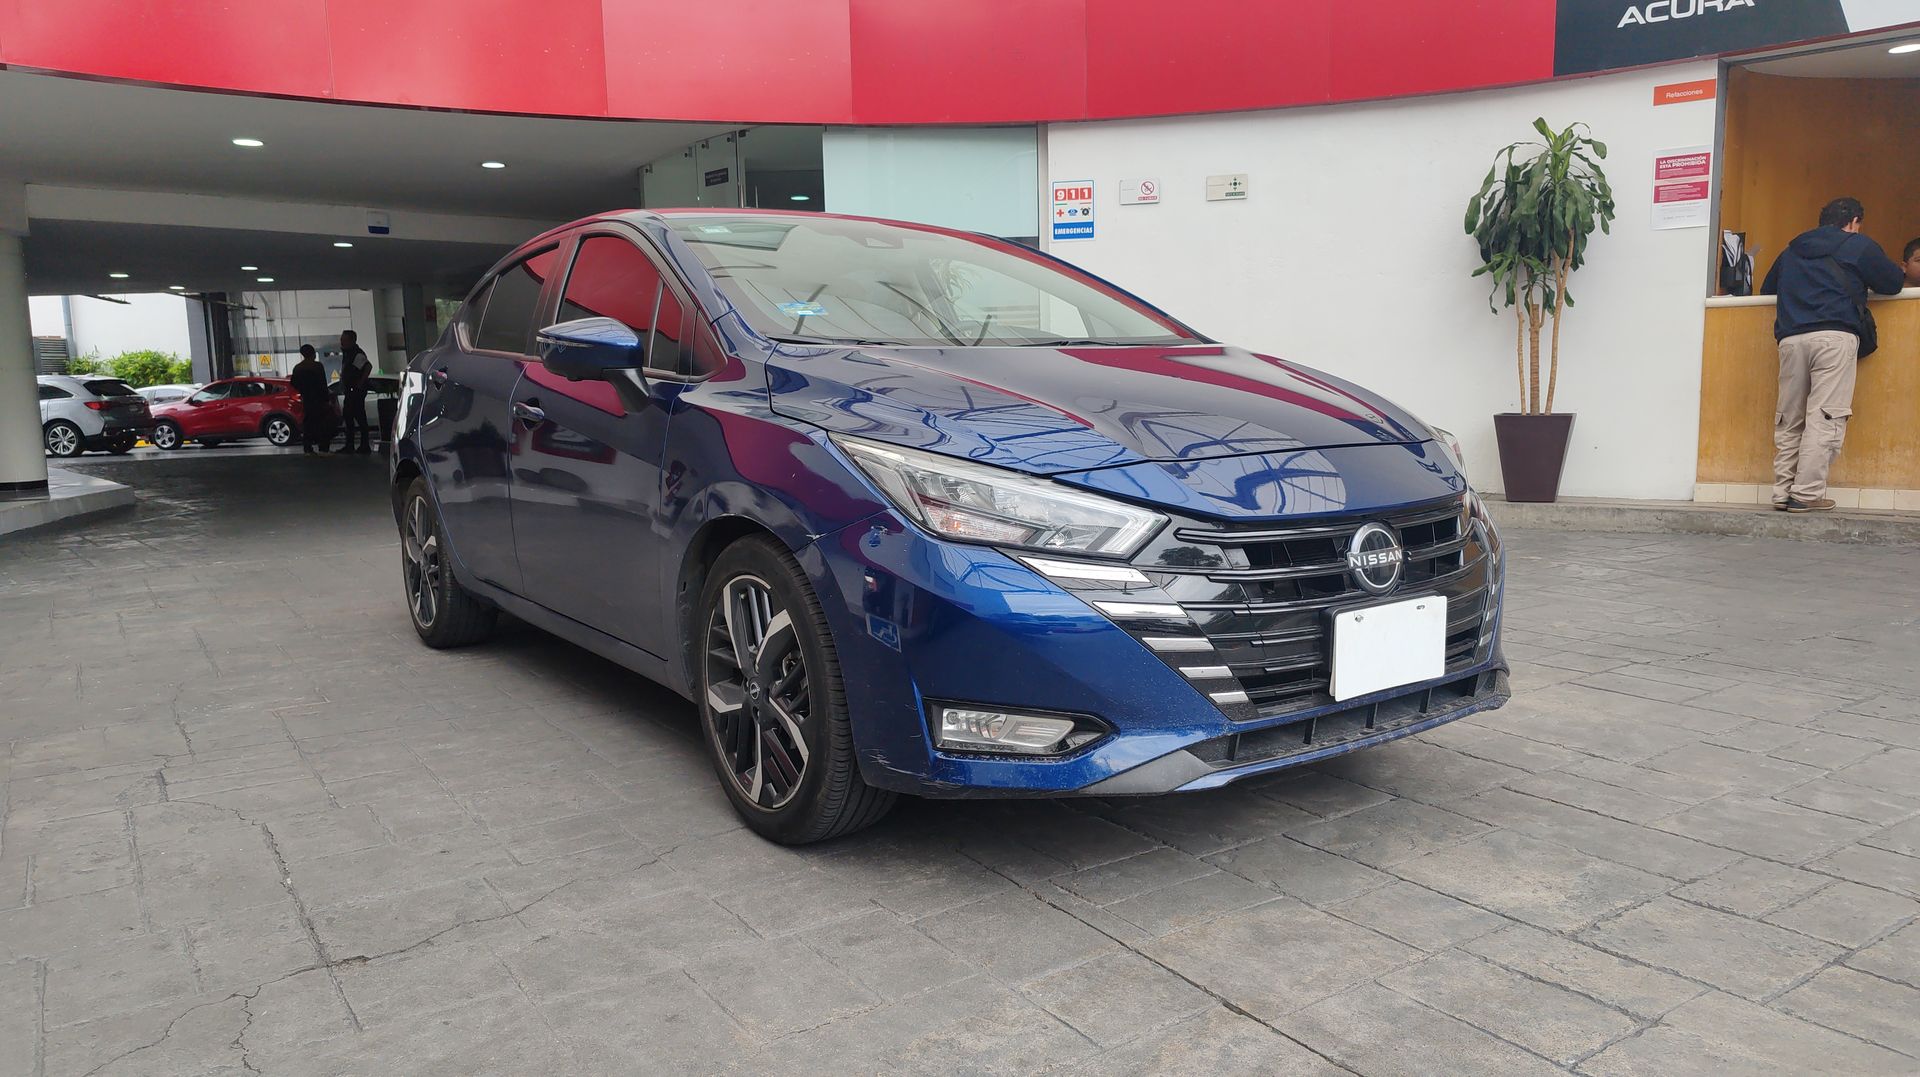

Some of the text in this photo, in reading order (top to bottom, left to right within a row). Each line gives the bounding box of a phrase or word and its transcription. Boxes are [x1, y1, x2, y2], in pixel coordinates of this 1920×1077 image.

[1617, 0, 1755, 28] ACURA
[1665, 89, 1703, 98] Refacciones
[1056, 188, 1089, 200] 911
[1054, 227, 1093, 235] EMERGENCIAS
[1350, 550, 1402, 567] NISSAN
